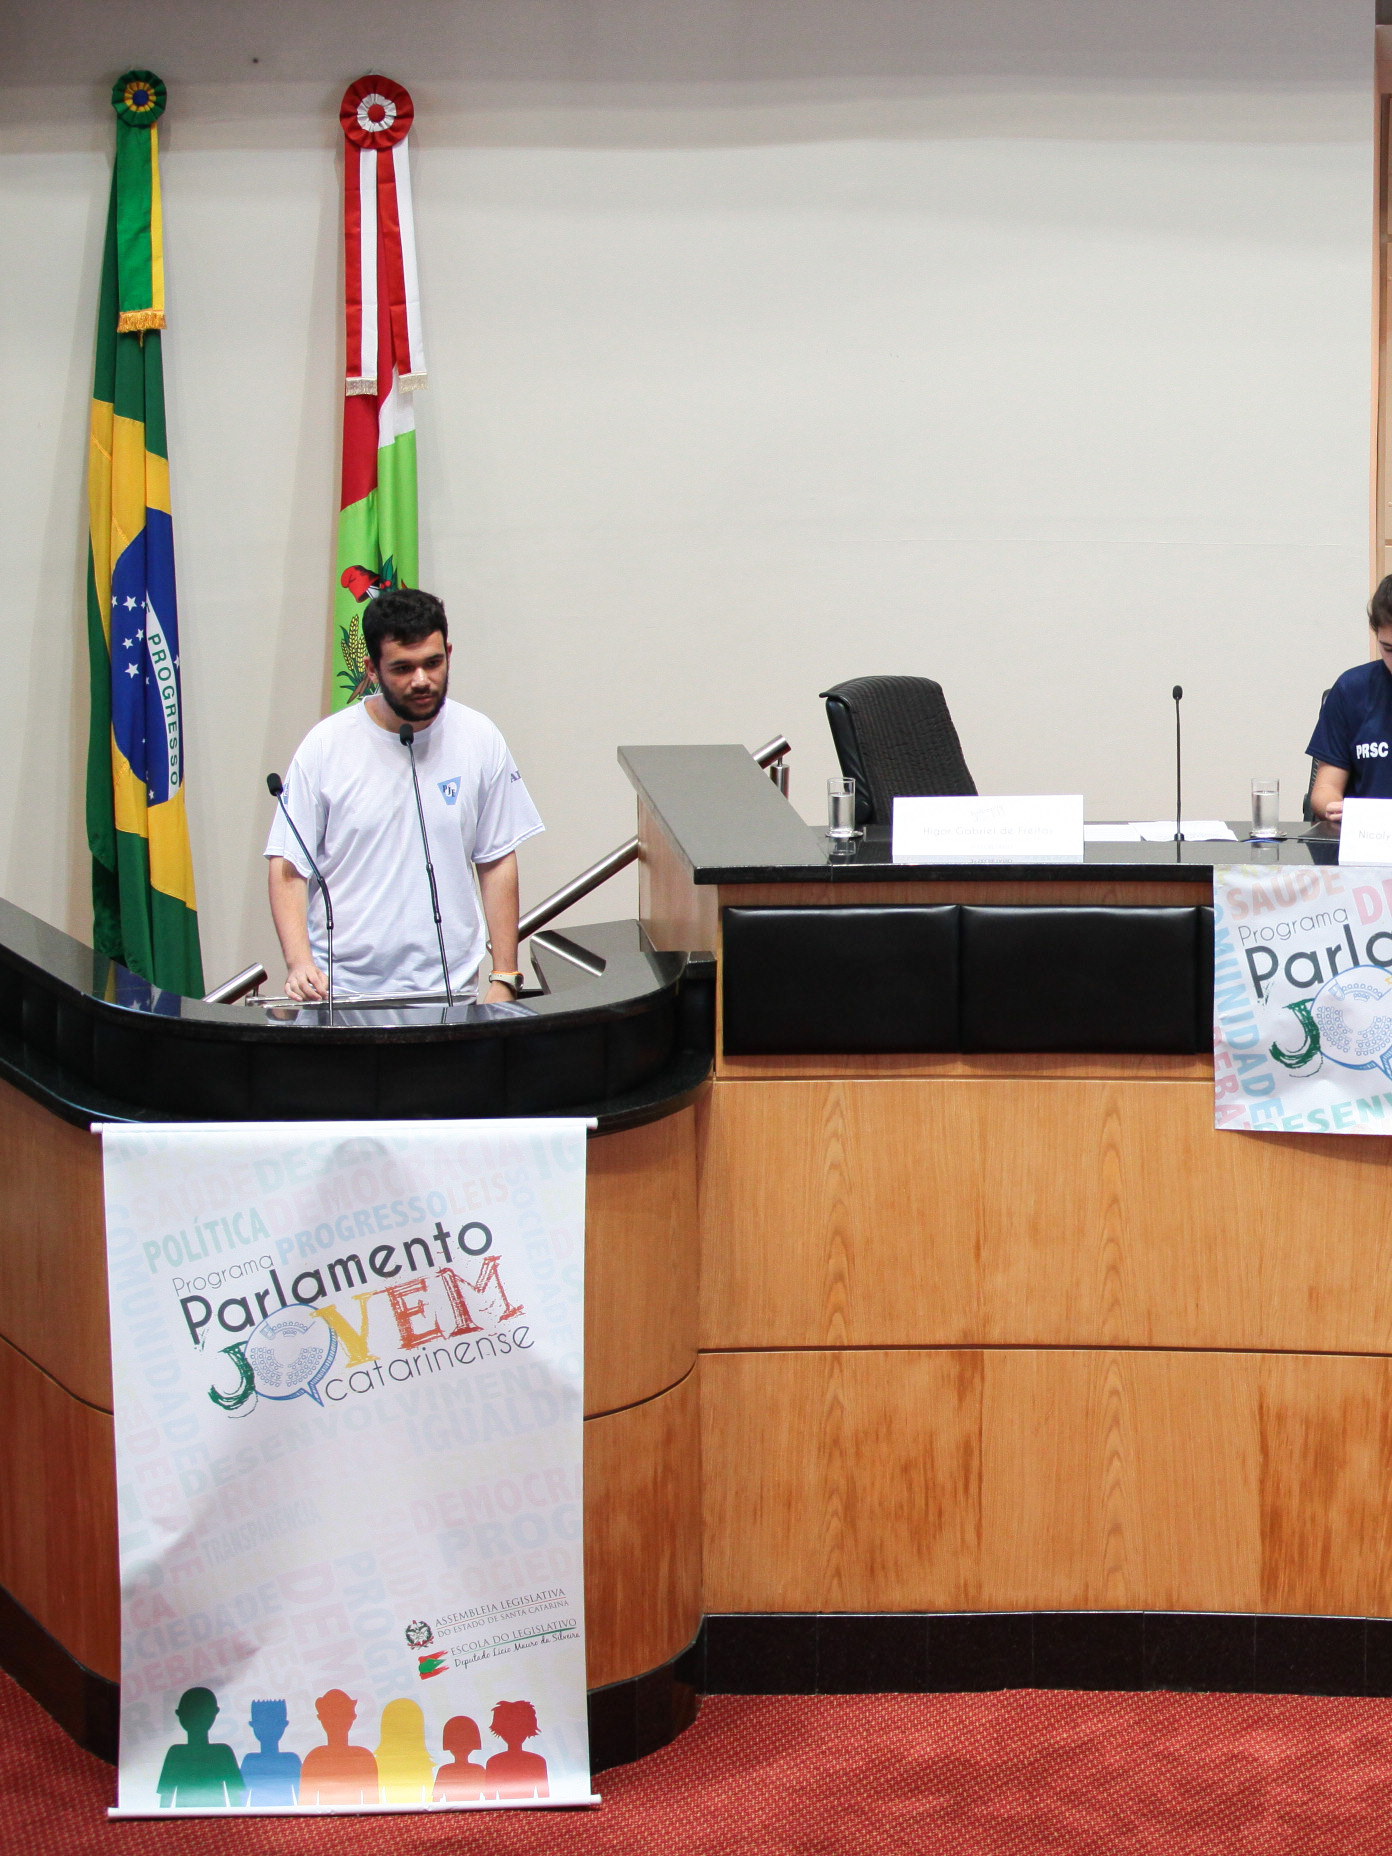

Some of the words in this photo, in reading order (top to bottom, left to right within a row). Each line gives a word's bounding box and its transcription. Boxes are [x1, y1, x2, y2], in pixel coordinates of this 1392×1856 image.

[148, 633, 178, 786] PROGRESSO
[1356, 742, 1389, 760] PRSC
[442, 784, 456, 797] PJE
[1237, 903, 1350, 948] Programa
[446, 1172, 509, 1216] LEIS
[142, 1207, 271, 1274] POLÍTICA
[275, 1190, 448, 1266] PROGRESSO
[171, 1252, 274, 1297] Programa
[179, 1221, 493, 1346] Parlamento
[208, 1254, 525, 1415] JOVEM
[325, 1325, 535, 1402] catarinense
[435, 1603, 498, 1627] ASSEMBLEIA
[500, 1588, 566, 1610] LEGISLATIVA
[437, 1628, 452, 1638] DO
[453, 1619, 486, 1634] ESTADO
[488, 1616, 499, 1625] DE
[500, 1609, 528, 1622] SANTA
[528, 1600, 569, 1615] CATARINA
[450, 1638, 491, 1656] ESCOLA
[493, 1632, 510, 1645] DO
[512, 1618, 578, 1640] LEGISLATIVO
[455, 1652, 491, 1669] Deputado
